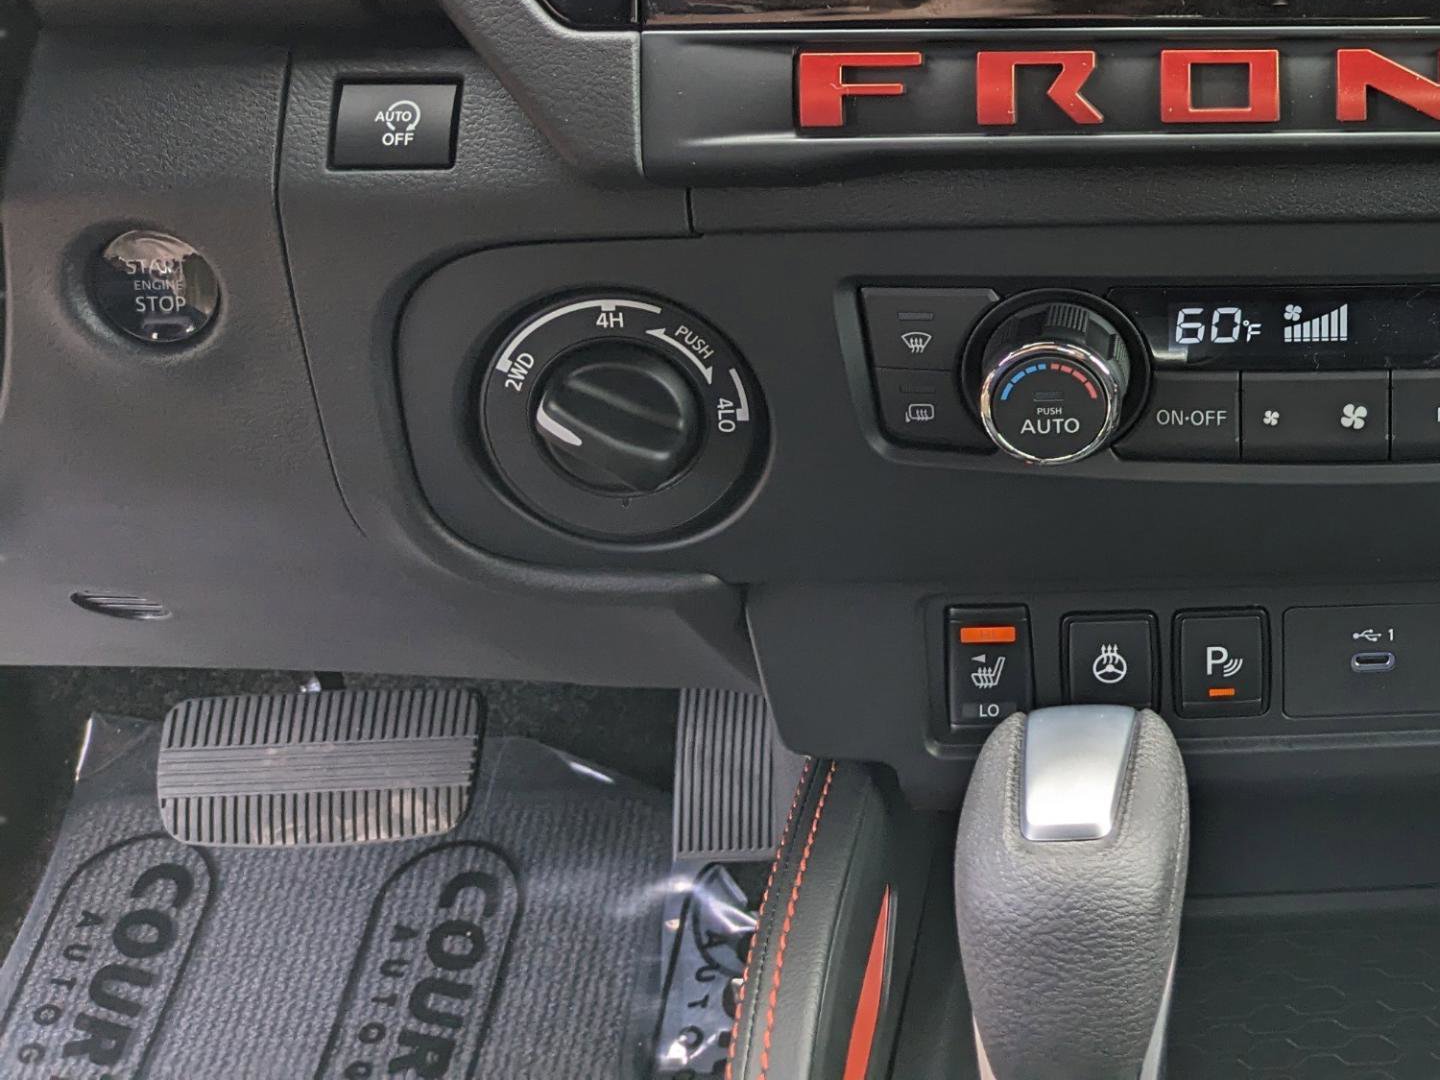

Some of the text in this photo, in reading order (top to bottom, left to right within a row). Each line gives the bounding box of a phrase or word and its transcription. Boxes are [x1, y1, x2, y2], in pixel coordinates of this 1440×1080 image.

[373, 108, 414, 124] AUTO
[380, 130, 415, 148] OFF
[134, 279, 185, 292] ENGINE
[134, 294, 187, 314] STOP
[596, 312, 624, 328] 4H
[675, 325, 715, 360] PUSH
[504, 352, 534, 392] 2WD
[716, 397, 736, 433] 4LO
[1035, 406, 1064, 417] PUSH
[1020, 417, 1081, 436] AUTO
[1386, 628, 1395, 642] 1
[978, 702, 1001, 718] LO
[62, 862, 194, 1080] COUR
